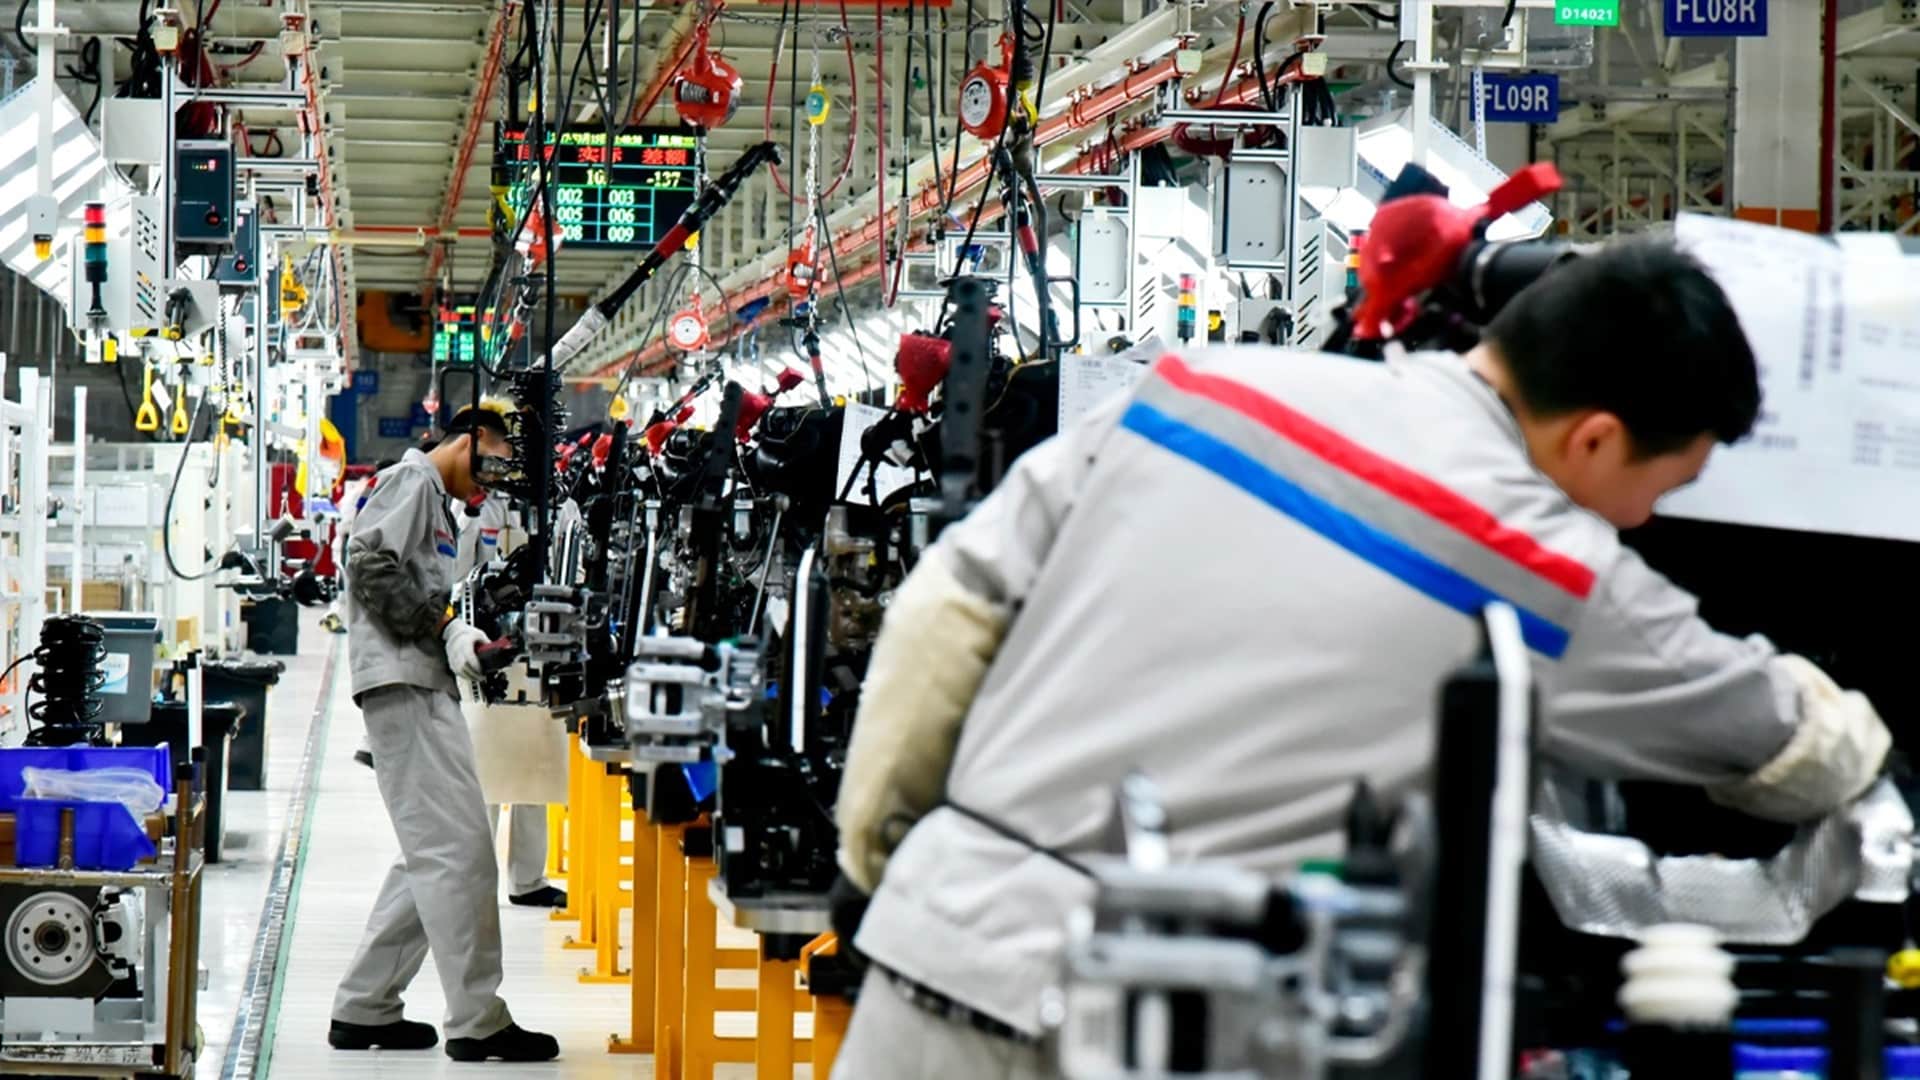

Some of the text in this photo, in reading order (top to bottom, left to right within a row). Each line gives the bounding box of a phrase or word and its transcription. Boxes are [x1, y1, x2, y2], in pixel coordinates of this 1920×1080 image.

[1561, 7, 1613, 21] D14021
[1676, 0, 1756, 23] FL08R
[1482, 84, 1549, 111] FL09R
[557, 188, 635, 206] 002 003
[557, 206, 635, 224] 005 006
[607, 226, 634, 242] 009
